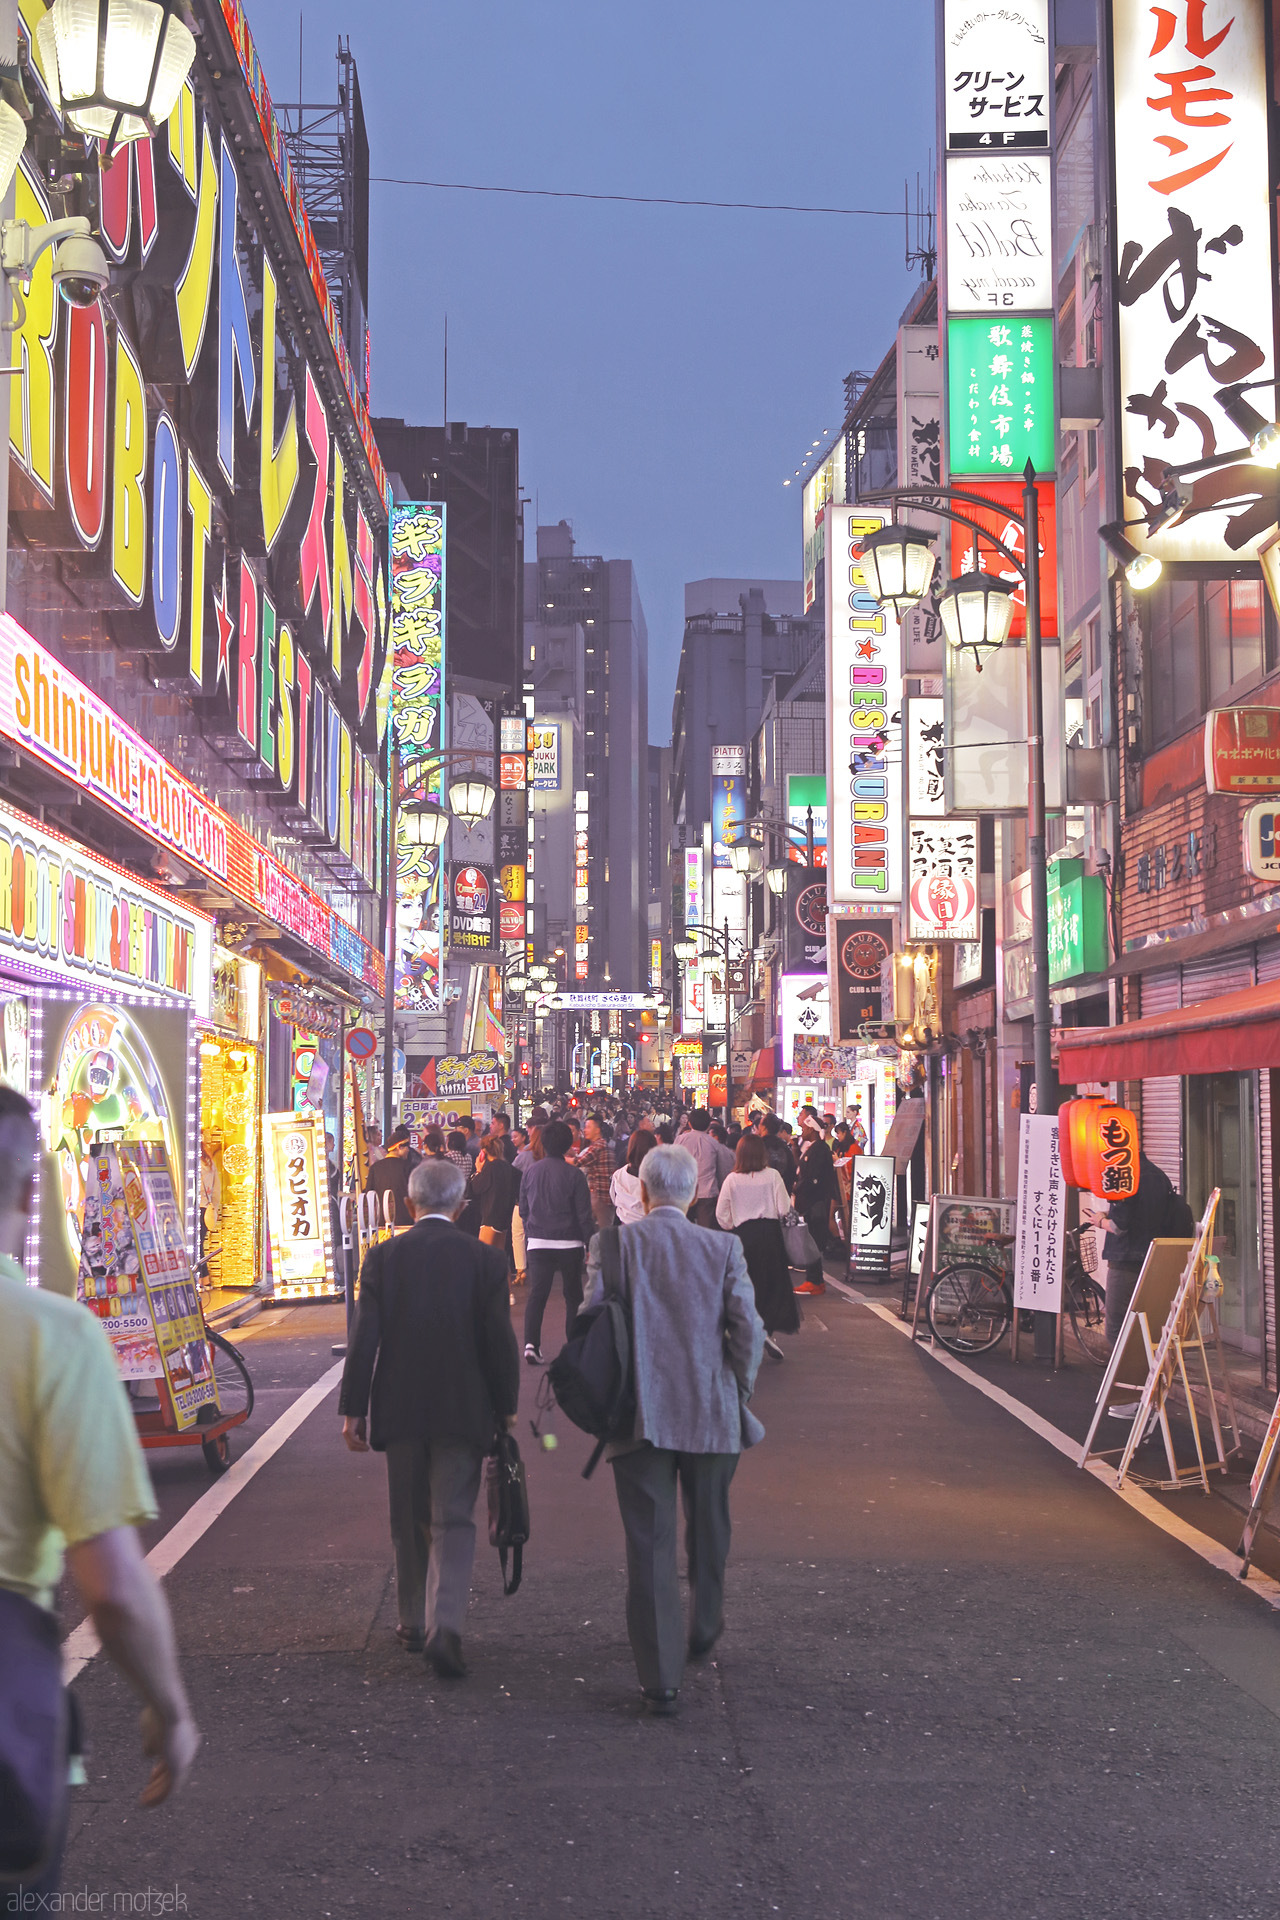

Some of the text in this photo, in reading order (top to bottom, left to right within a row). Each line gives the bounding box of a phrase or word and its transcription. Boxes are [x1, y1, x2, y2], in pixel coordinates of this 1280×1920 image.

[953, 71, 1025, 92] クリーン
[968, 95, 1045, 118] サービス
[987, 325, 1014, 468] 歌舞伎市場
[967, 368, 982, 457] こだわり食材
[714, 747, 744, 756] PIATTO
[792, 815, 828, 832] Faily
[929, 879, 957, 920] 縁日
[0, 836, 60, 949] ROBOT
[64, 870, 112, 967] SHOW
[120, 898, 195, 996] RESTAURANT
[505, 1015, 514, 1049] カラオケ
[466, 1076, 497, 1092] 受付
[1100, 1117, 1136, 1194] もつ鍋
[97, 1158, 118, 1267] ロボットレストラン
[84, 1273, 139, 1298] ROBOT
[87, 1296, 138, 1319] SHOW
